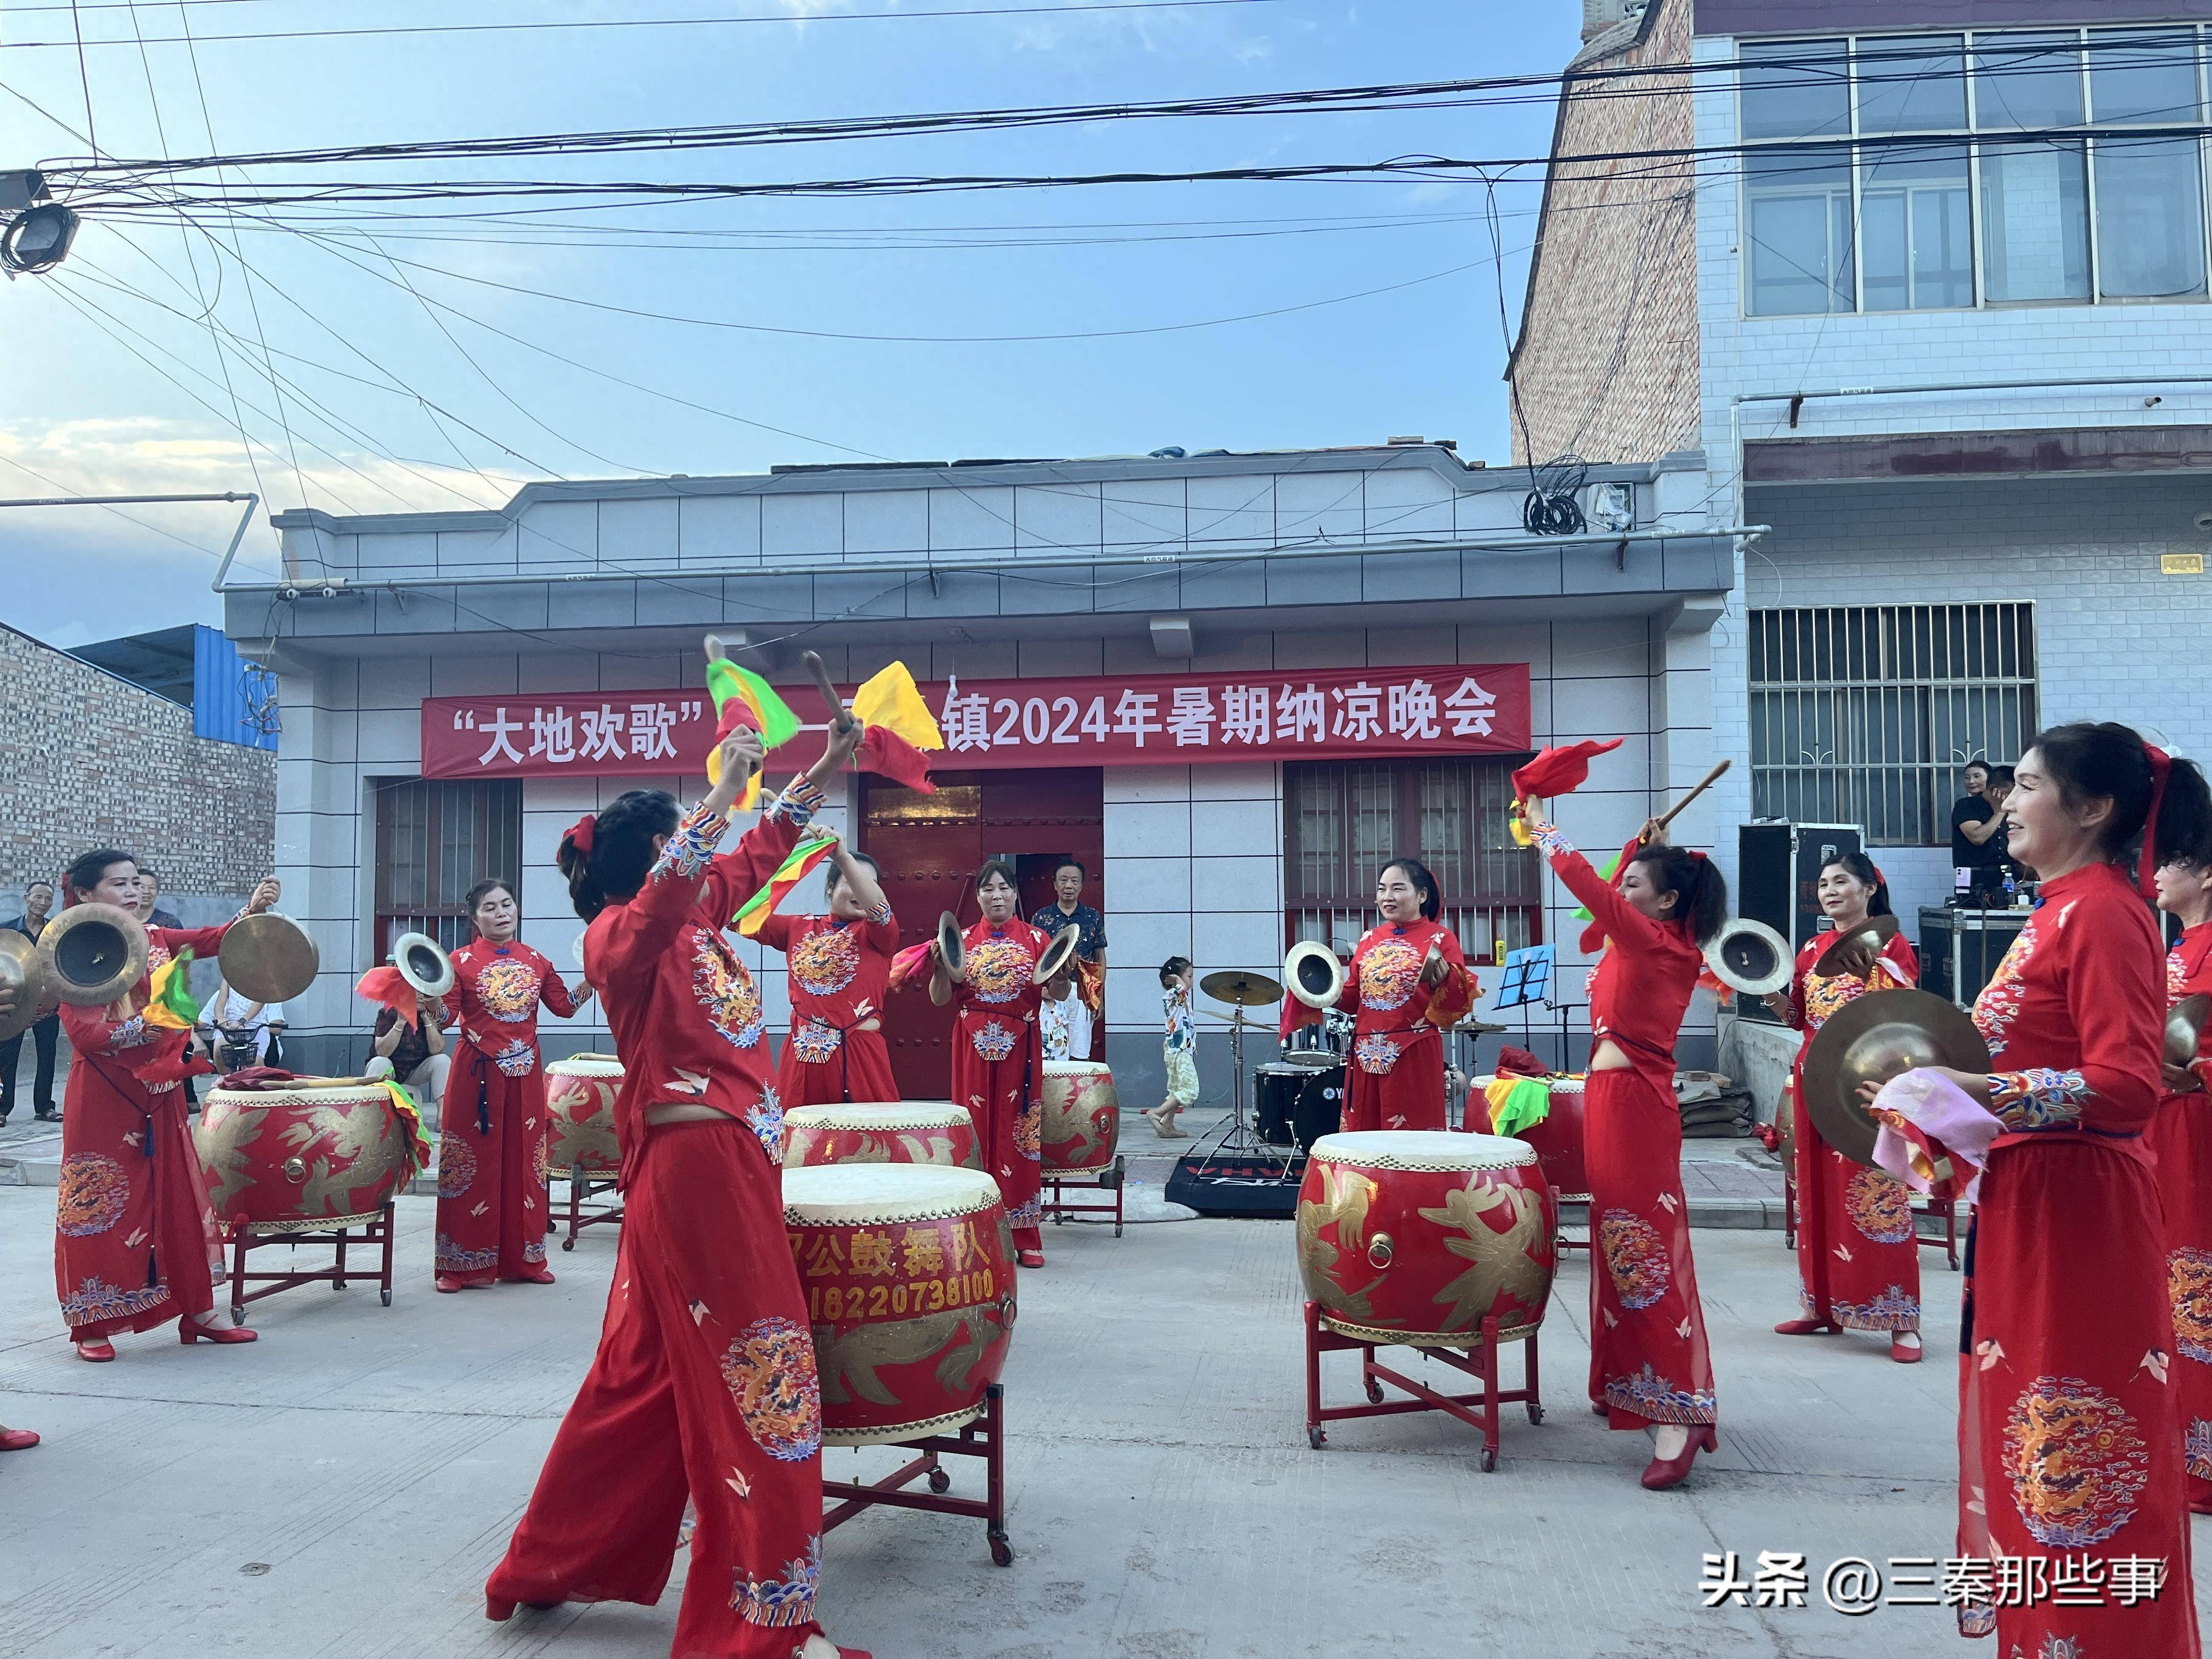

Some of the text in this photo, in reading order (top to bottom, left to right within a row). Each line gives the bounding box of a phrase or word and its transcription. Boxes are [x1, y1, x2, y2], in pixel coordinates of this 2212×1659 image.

[842, 676, 1497, 753] 镇2024年暑期纳凉晚会
[811, 1268, 994, 1321] 18220738100
